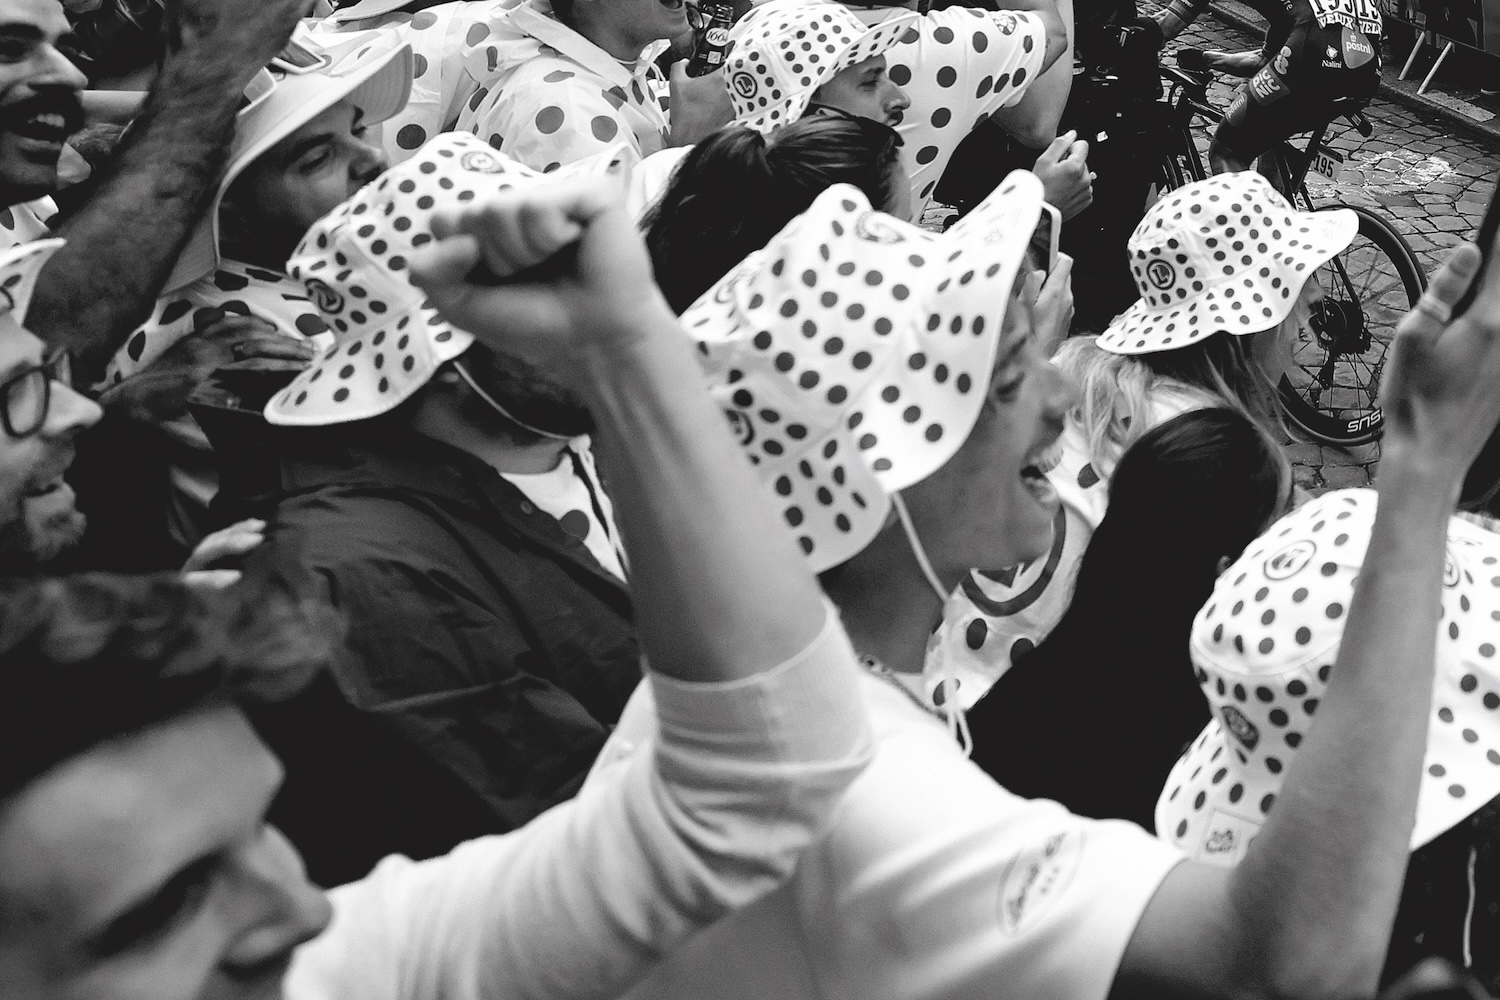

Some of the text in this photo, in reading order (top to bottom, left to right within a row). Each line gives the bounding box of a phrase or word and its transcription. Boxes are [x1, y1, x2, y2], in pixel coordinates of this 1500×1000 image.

[1319, 13, 1355, 31] VELUX
[1346, 41, 1371, 55] postnl
[1322, 60, 1342, 69] Nalini
[1315, 153, 1335, 179] 195
[1347, 408, 1384, 432] SUS
